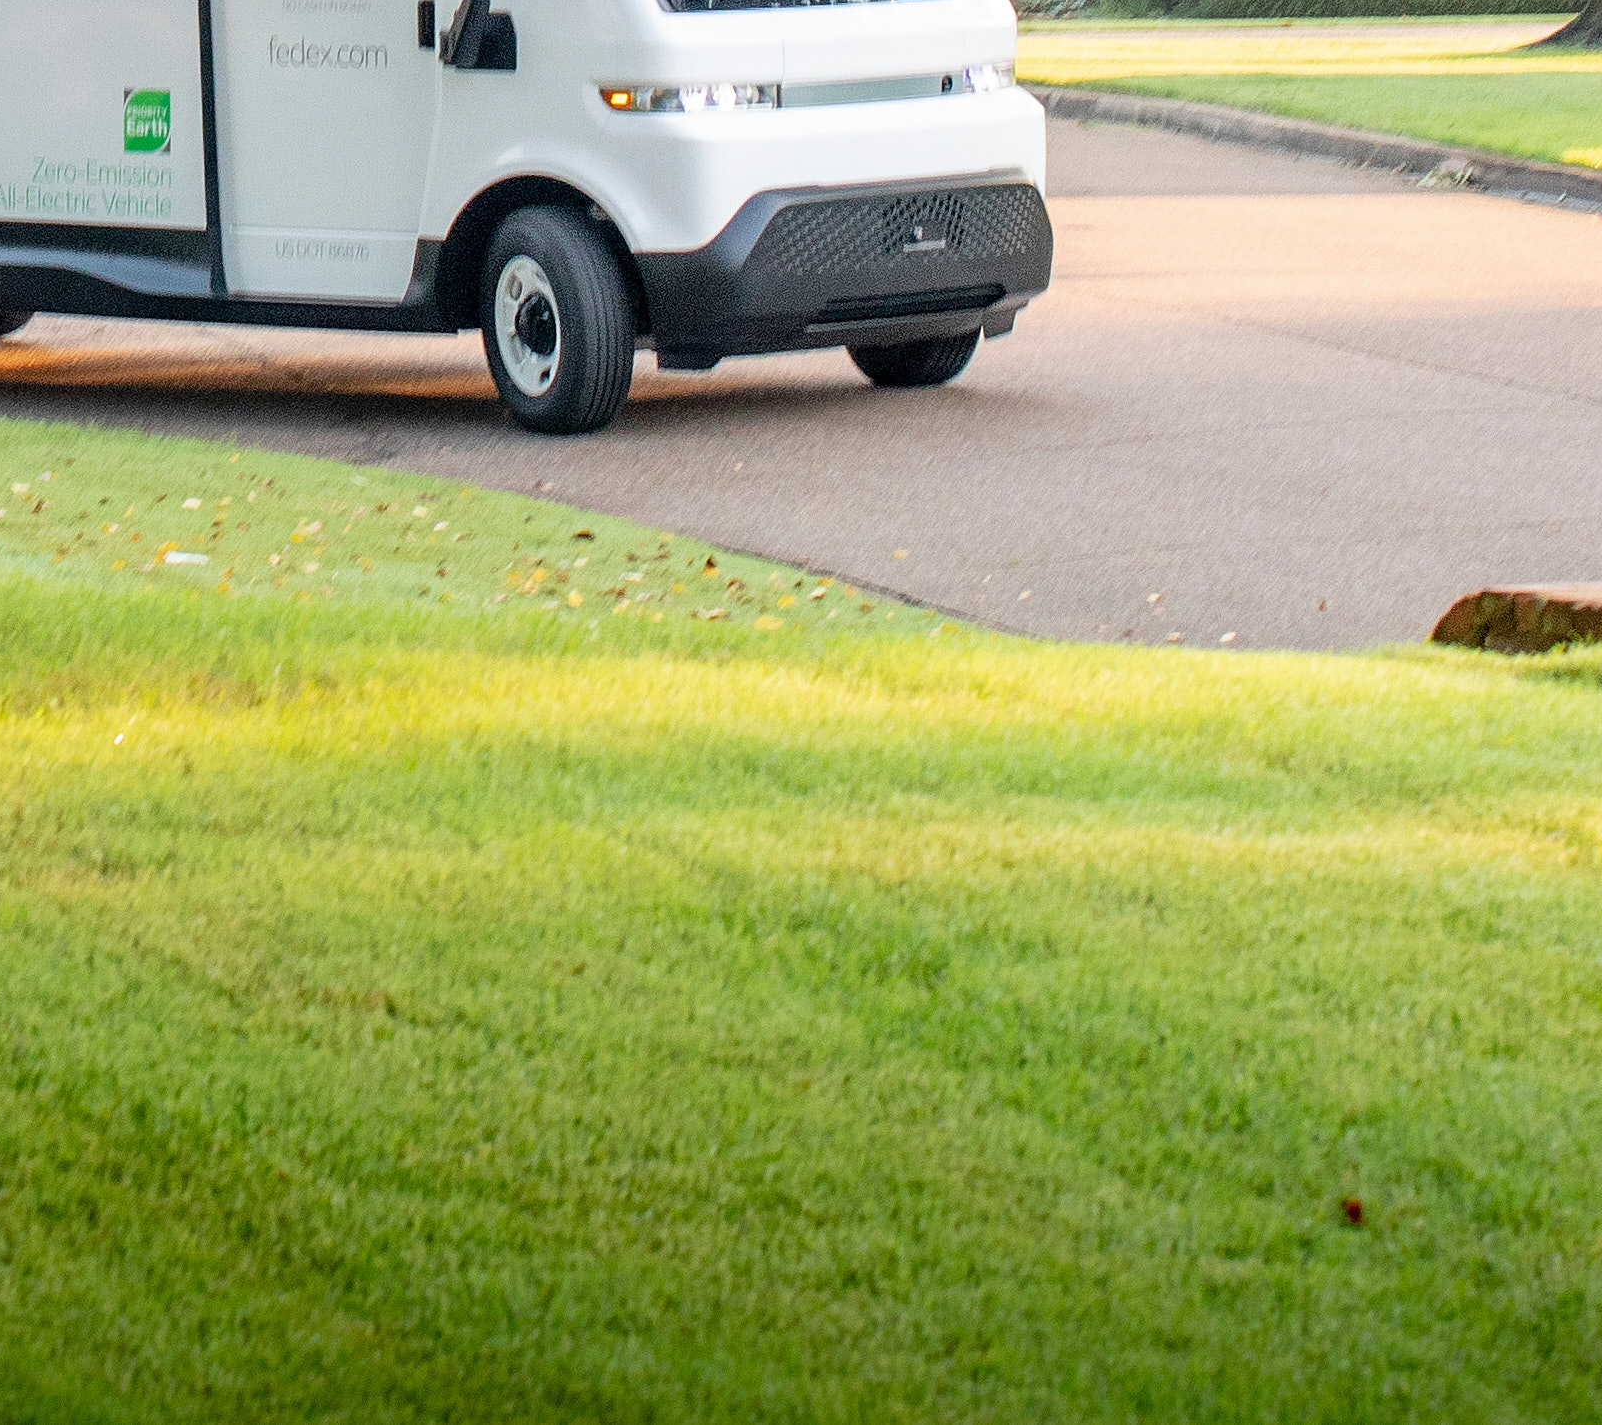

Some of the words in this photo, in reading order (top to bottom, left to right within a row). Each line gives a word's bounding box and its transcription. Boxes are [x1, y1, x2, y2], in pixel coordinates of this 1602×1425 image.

[269, 35, 389, 69] fedex.com
[126, 118, 168, 138] Earth
[32, 156, 173, 189] Zero-Emission
[101, 188, 172, 219] Vehicle
